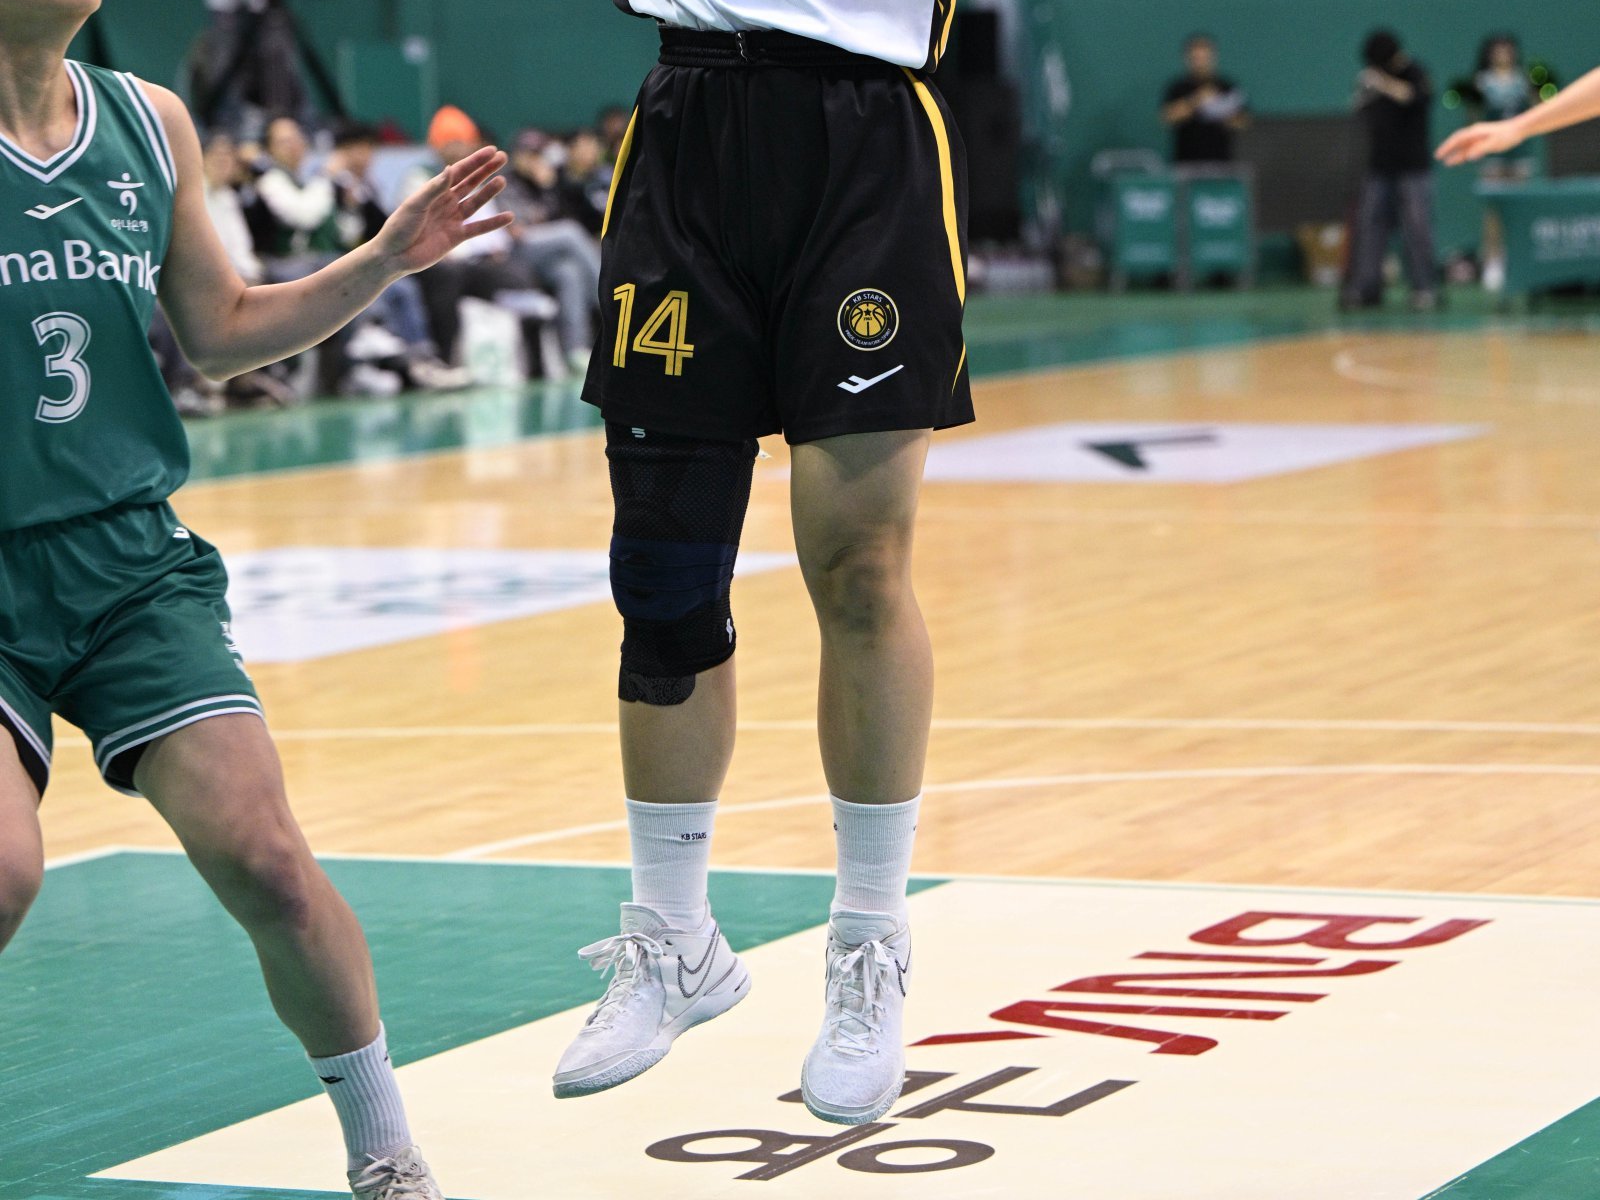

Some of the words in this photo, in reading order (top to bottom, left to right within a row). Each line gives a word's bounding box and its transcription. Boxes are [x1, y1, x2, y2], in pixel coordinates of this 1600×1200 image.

[64, 240, 161, 295] Bank
[852, 295, 862, 304] KB
[863, 293, 883, 303] STARS
[612, 282, 694, 377] 14
[31, 311, 91, 424] 3
[681, 833, 691, 841] KB
[907, 910, 1494, 1056] BNK
